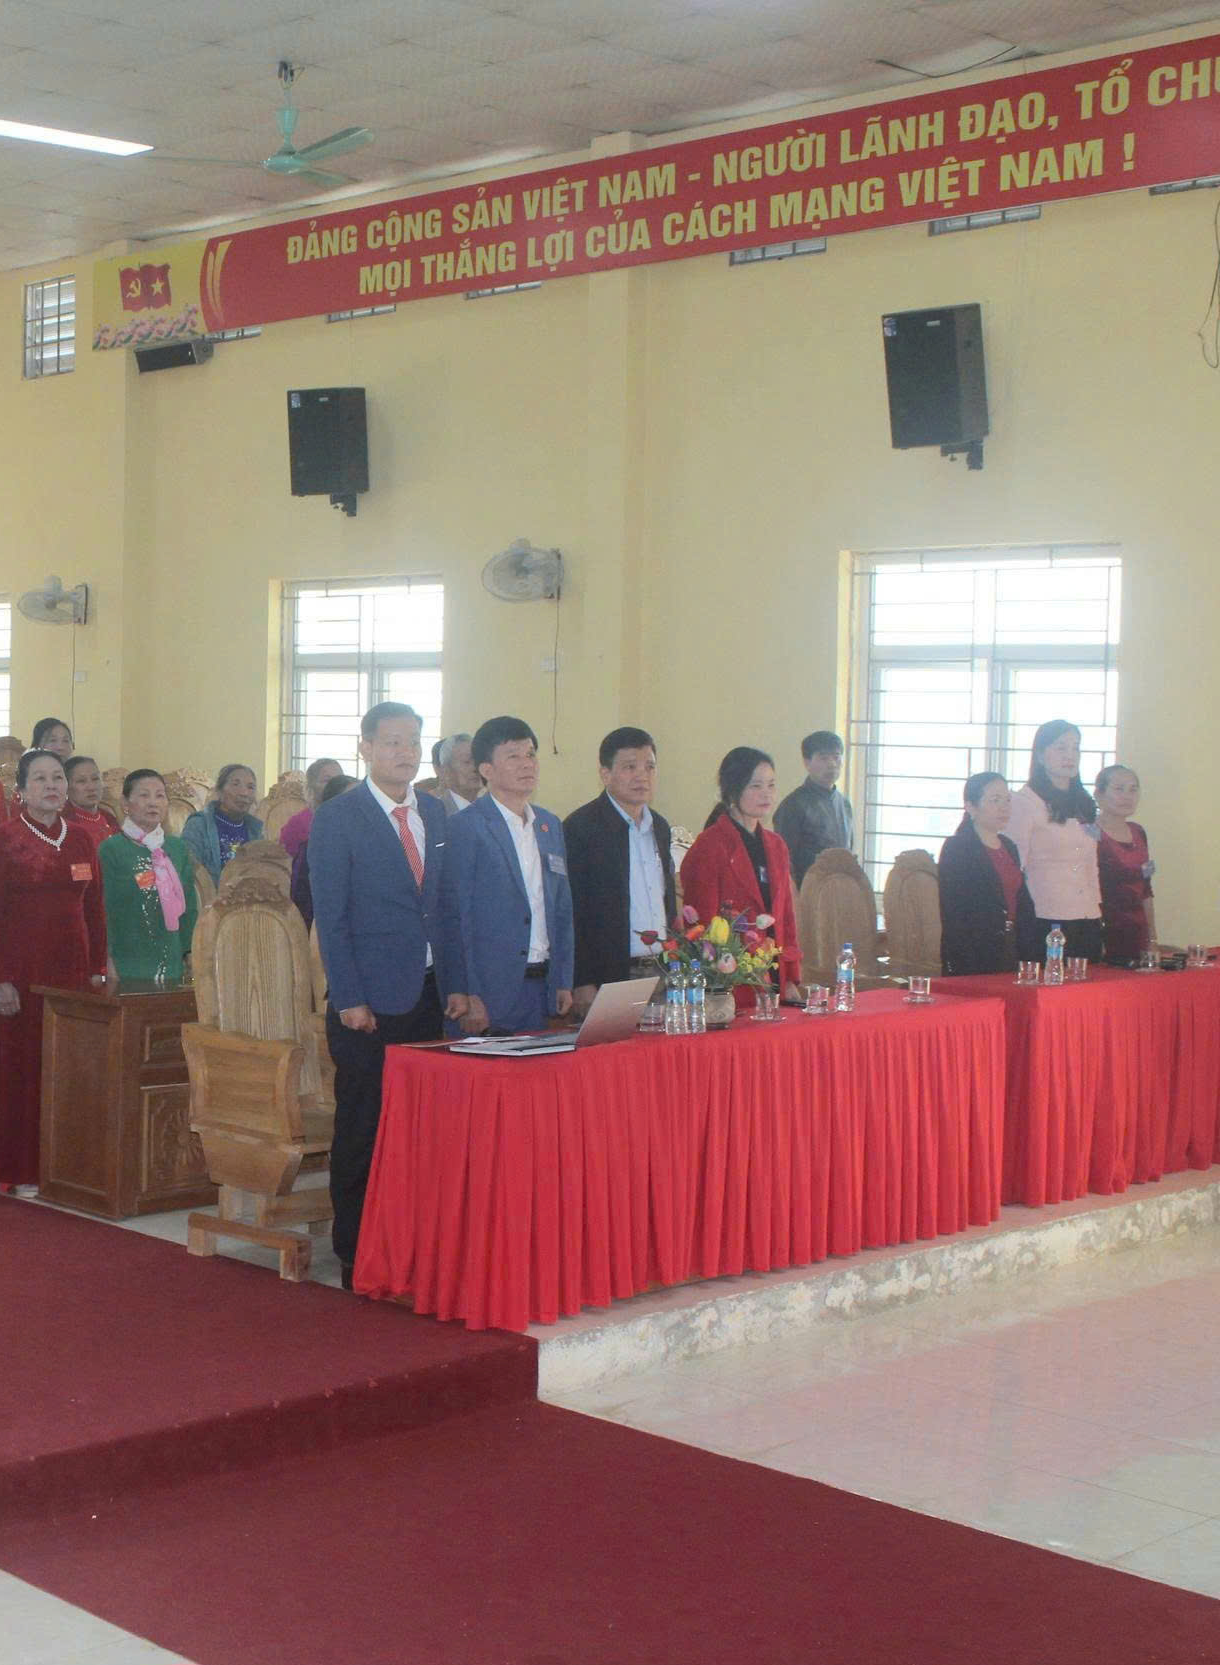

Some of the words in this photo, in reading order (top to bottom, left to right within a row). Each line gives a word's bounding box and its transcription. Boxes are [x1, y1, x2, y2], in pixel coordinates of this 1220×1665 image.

[286, 220, 358, 264] ĐẢNG
[366, 210, 442, 252] CỘNG
[451, 187, 513, 234] SẢN
[522, 177, 588, 222] VIỆT
[599, 163, 676, 207] NAM
[713, 128, 826, 187] NGƯỜI
[840, 115, 945, 164] LÃNH
[958, 91, 1060, 144] ĐẠO,
[1075, 58, 1133, 120] TỔ
[1147, 56, 1220, 107] CH
[359, 259, 411, 296] MỌI
[420, 238, 517, 285] THẮNG
[527, 229, 574, 272] LỢI
[586, 208, 651, 258] CỦA
[662, 200, 757, 246] CÁCH
[770, 177, 885, 229] MẠNG
[899, 156, 985, 209] VIỆT
[999, 138, 1104, 192] NAM
[1123, 132, 1135, 171] !
